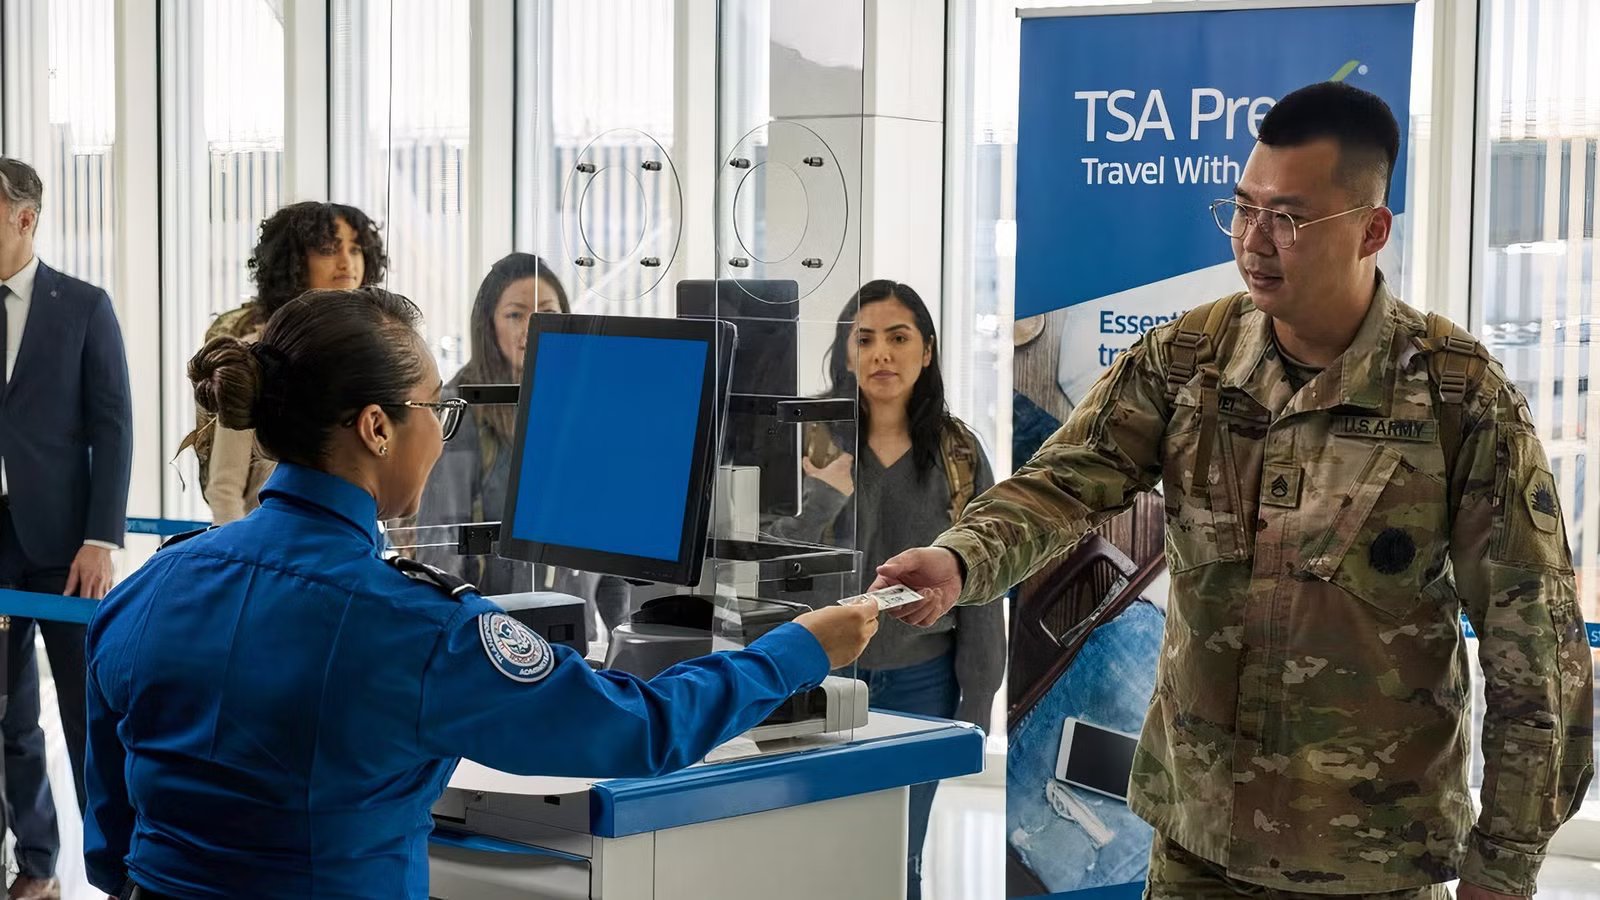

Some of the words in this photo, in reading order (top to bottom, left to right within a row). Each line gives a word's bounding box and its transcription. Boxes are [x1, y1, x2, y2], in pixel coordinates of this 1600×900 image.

[1074, 89, 1175, 142] TSA
[1081, 156, 1165, 184] Travel
[1174, 155, 1240, 184] With
[1373, 419, 1424, 438] ARMY
